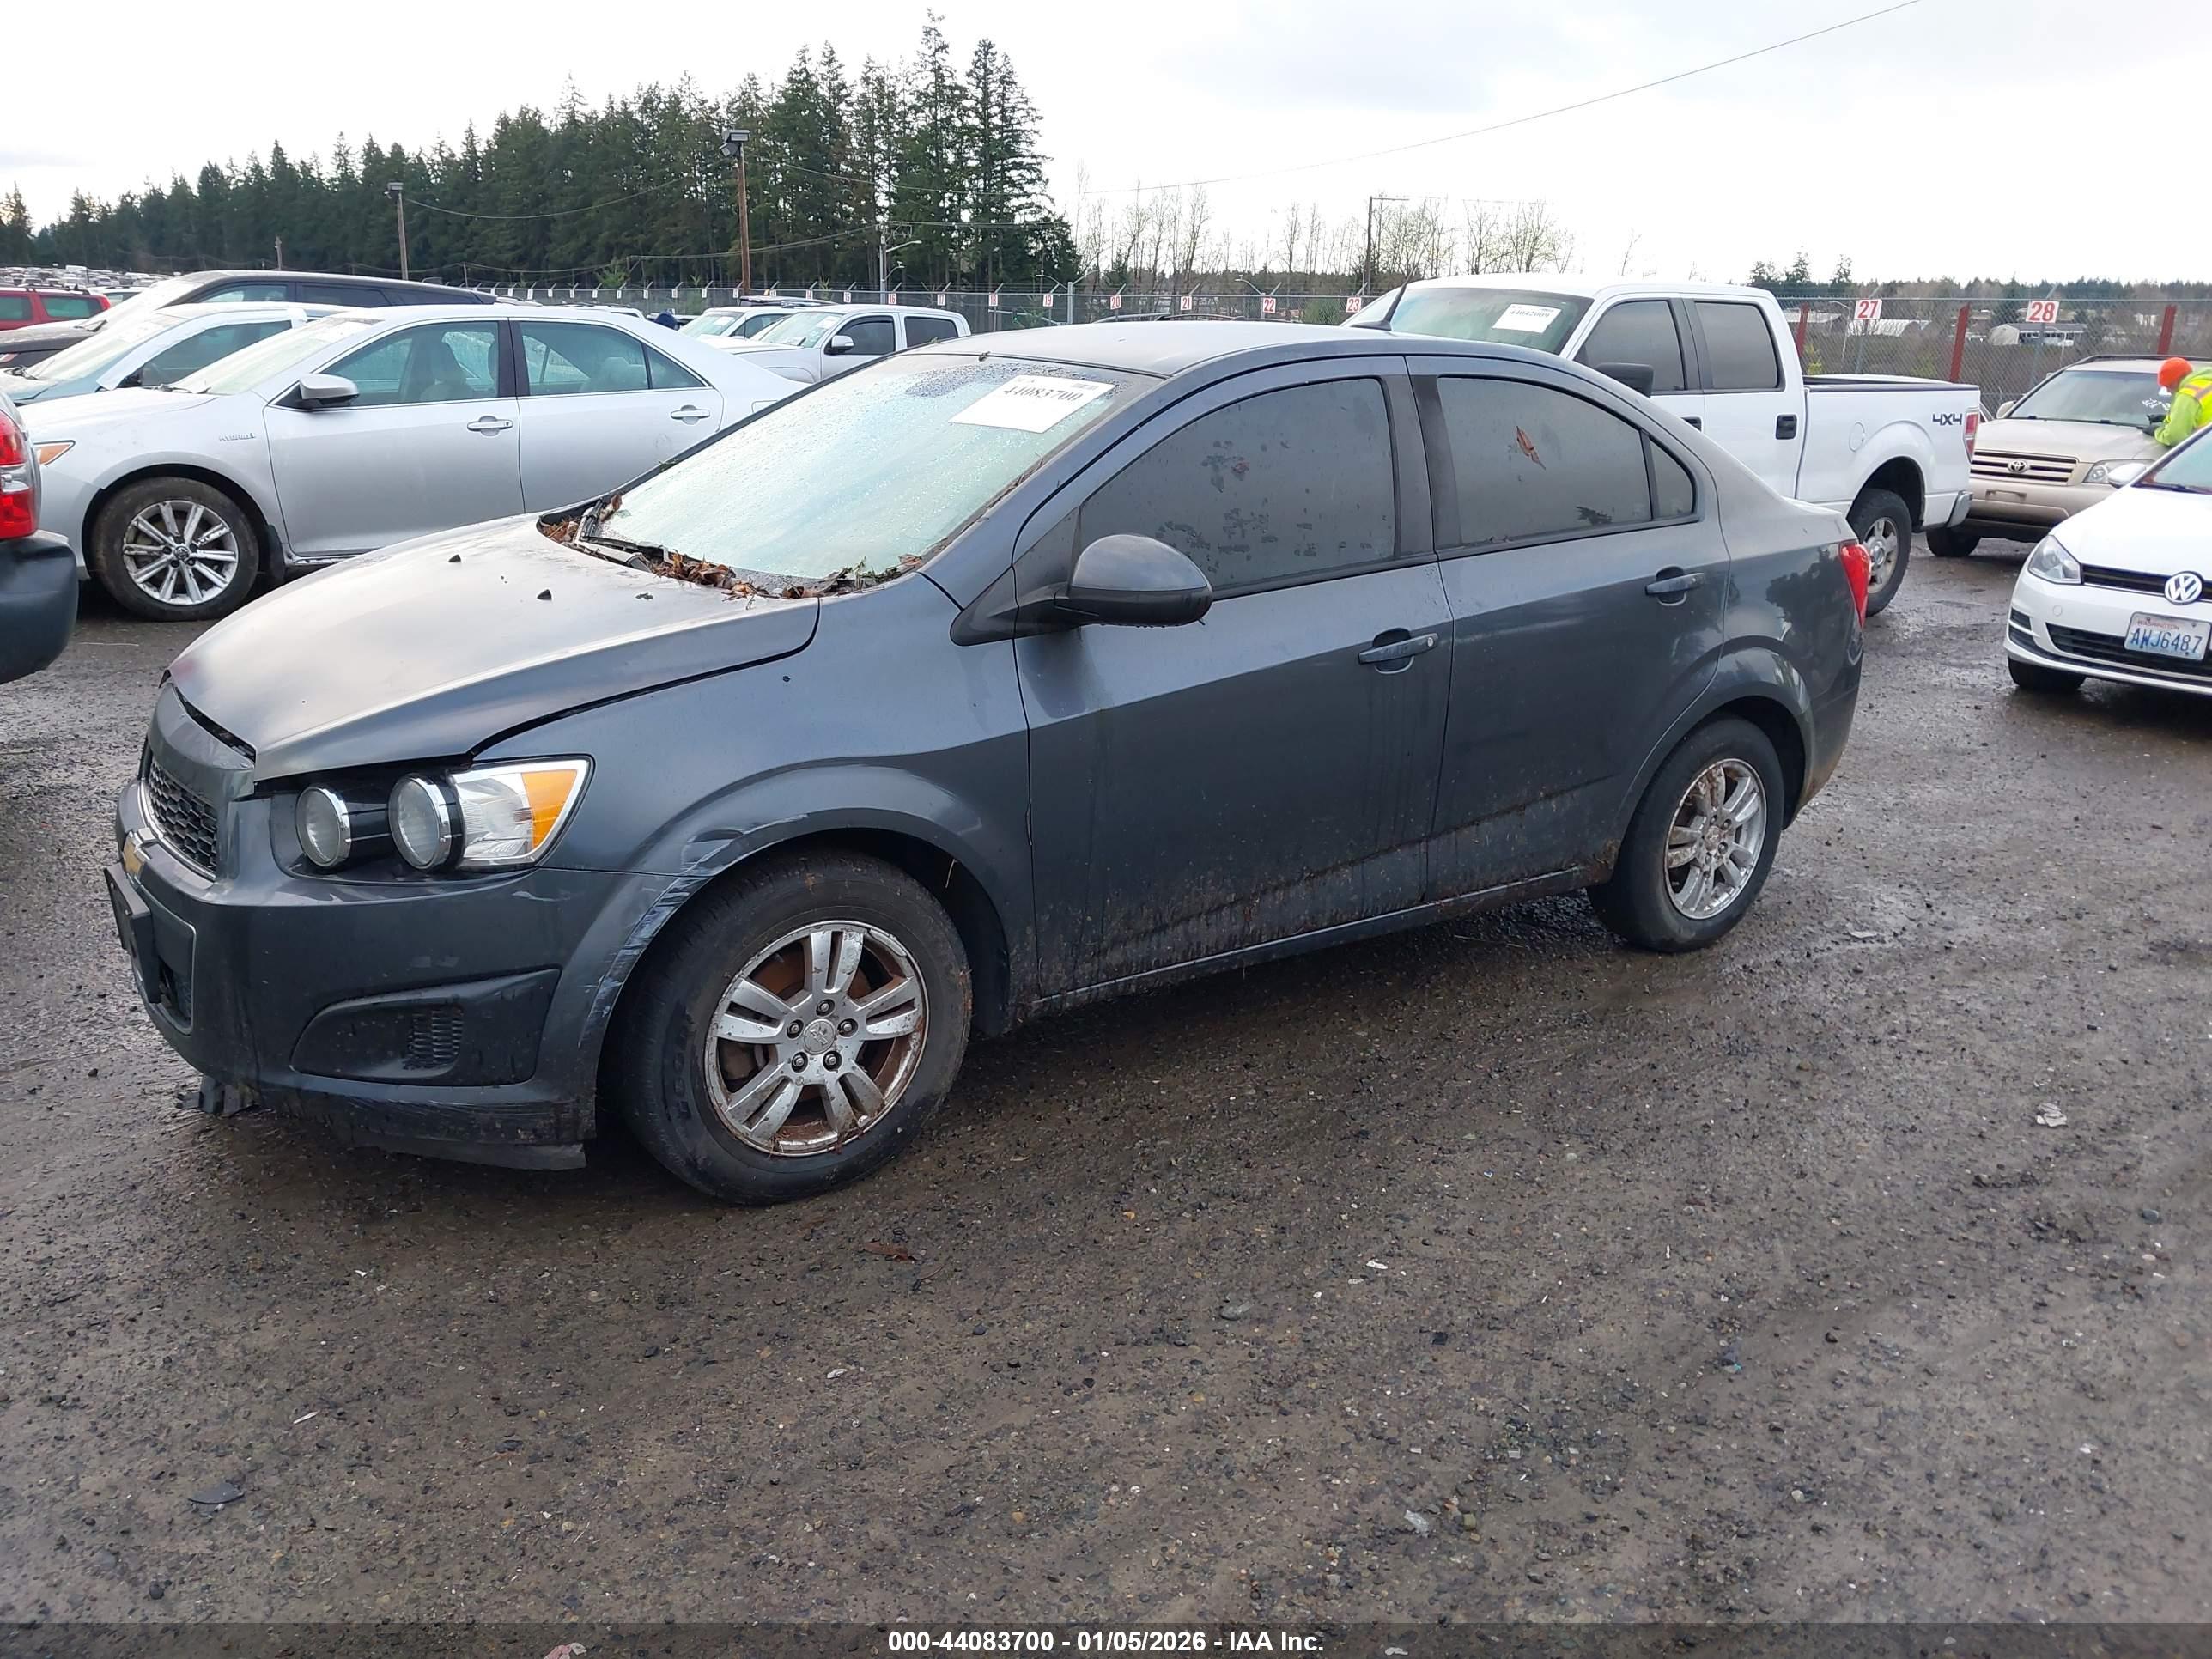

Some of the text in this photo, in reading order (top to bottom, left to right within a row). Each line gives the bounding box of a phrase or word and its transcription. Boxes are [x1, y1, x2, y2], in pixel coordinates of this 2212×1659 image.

[1045, 295, 1052, 306] 19
[1112, 296, 1121, 308] 20
[1182, 296, 1191, 309] 21
[1264, 299, 1275, 312] 22
[1348, 298, 1360, 311] 23
[1857, 301, 1879, 319] 27
[2028, 301, 2056, 321] 28
[1932, 413, 1963, 426] 4X4
[2130, 628, 2203, 653] AWJ6487
